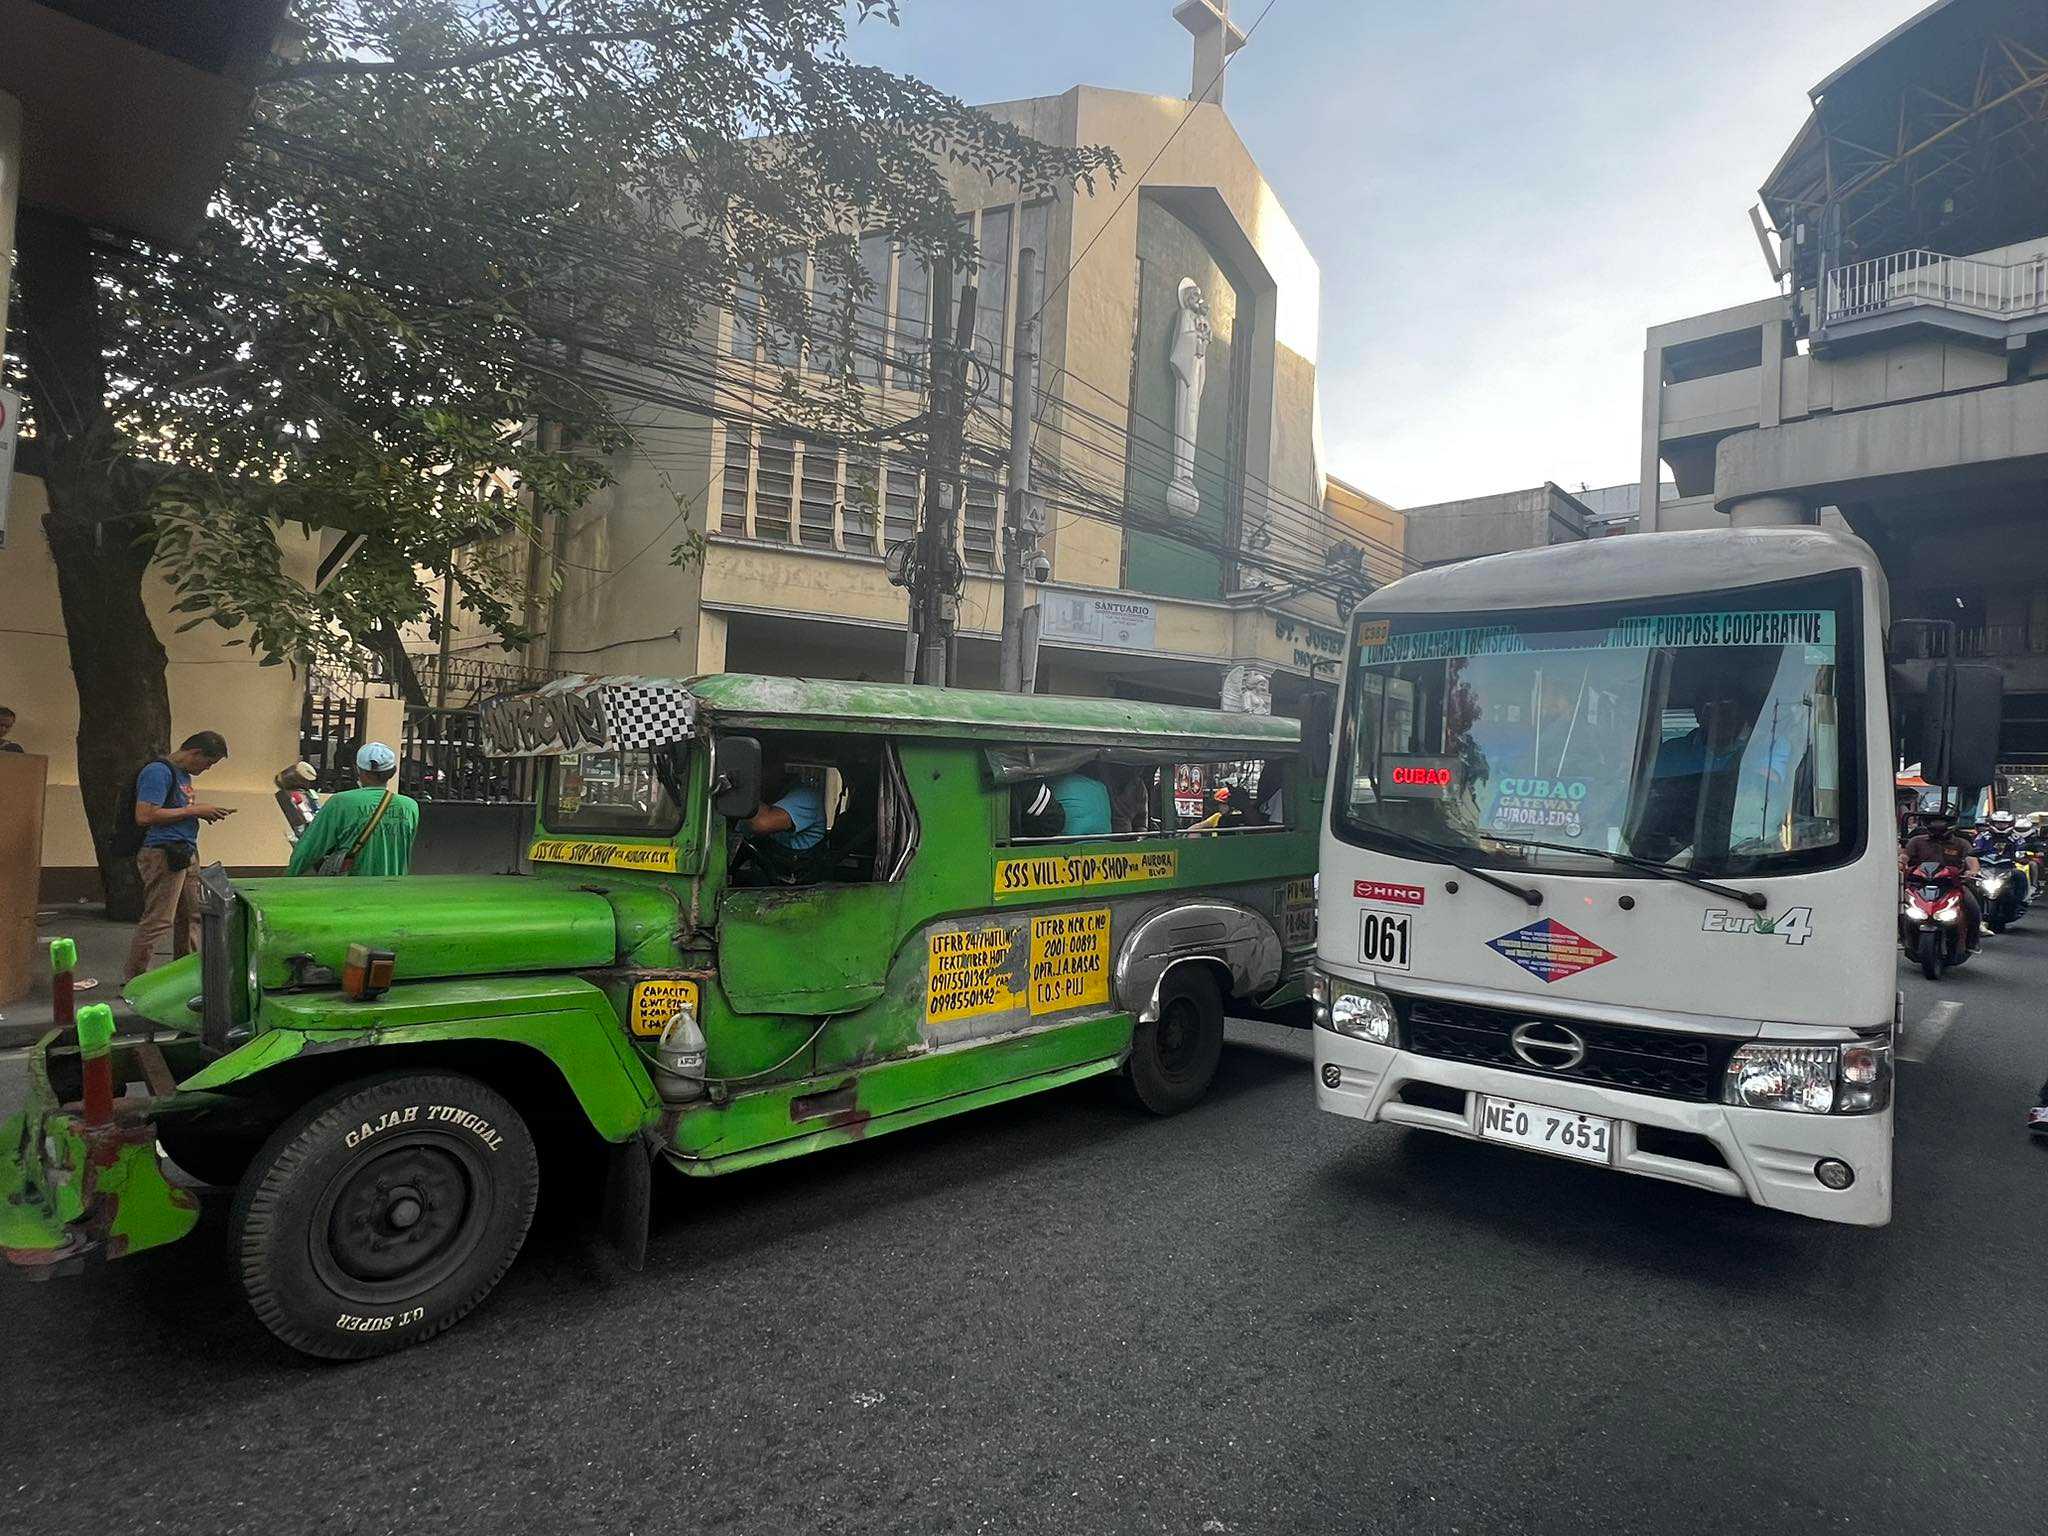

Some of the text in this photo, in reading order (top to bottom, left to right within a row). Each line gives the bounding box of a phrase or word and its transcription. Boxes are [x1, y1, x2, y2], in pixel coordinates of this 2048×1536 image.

[1095, 601, 1149, 615] SANTUARIO
[1722, 612, 1821, 645] COOPERATIVE
[1393, 767, 1451, 785] CUBAO
[1501, 778, 1587, 800] CUBAO
[1501, 797, 1581, 811] GATEWAY
[1004, 862, 1028, 888] SSS
[1141, 854, 1172, 867] AURORA
[1374, 886, 1421, 900] HINO
[1035, 918, 1065, 939] LTFRB
[932, 934, 964, 955] LTFRB
[1364, 914, 1408, 965] 061
[643, 986, 689, 998] CAPACITY
[930, 987, 996, 1015] 09985501342
[344, 1105, 504, 1152] GAJAH TUNGGAL
[1545, 1117, 1606, 1153] 7651
[335, 1313, 395, 1332] SUPER
